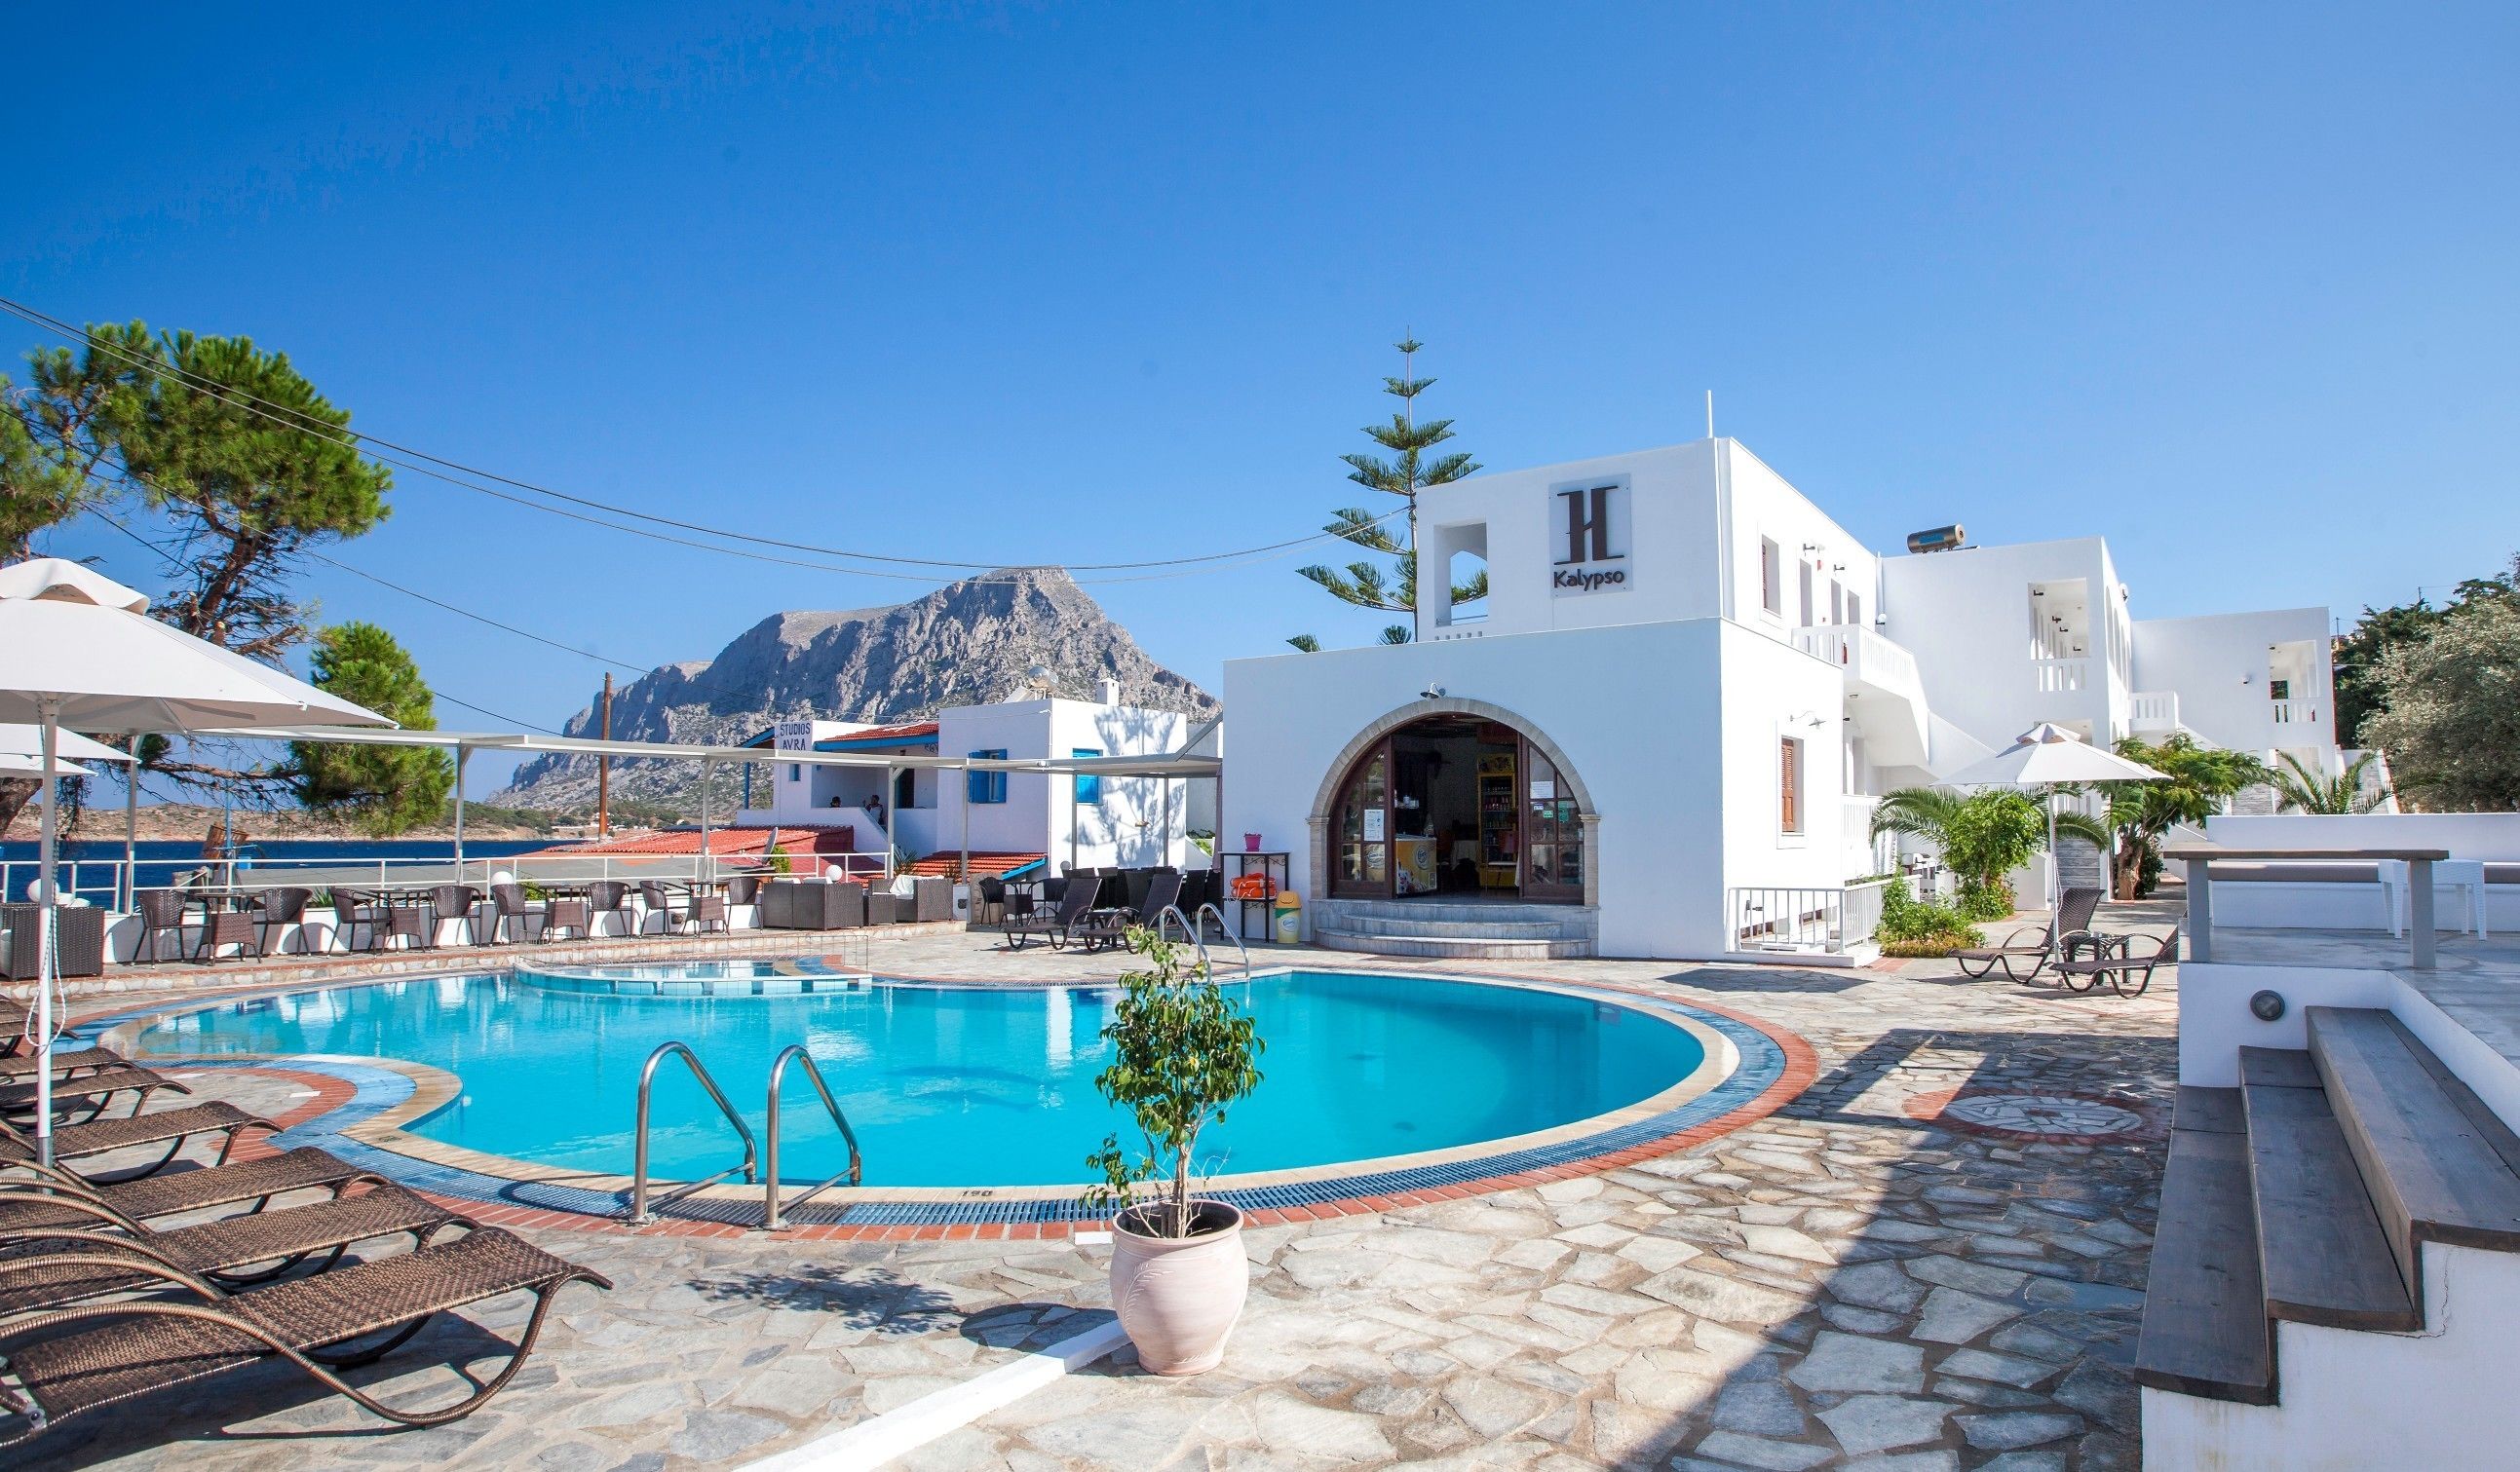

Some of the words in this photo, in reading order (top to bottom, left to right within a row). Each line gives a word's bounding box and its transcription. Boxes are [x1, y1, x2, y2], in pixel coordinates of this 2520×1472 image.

[1553, 568, 1625, 592] Kalypso
[780, 722, 811, 736] STUDIOS
[783, 737, 806, 750] AVRA
